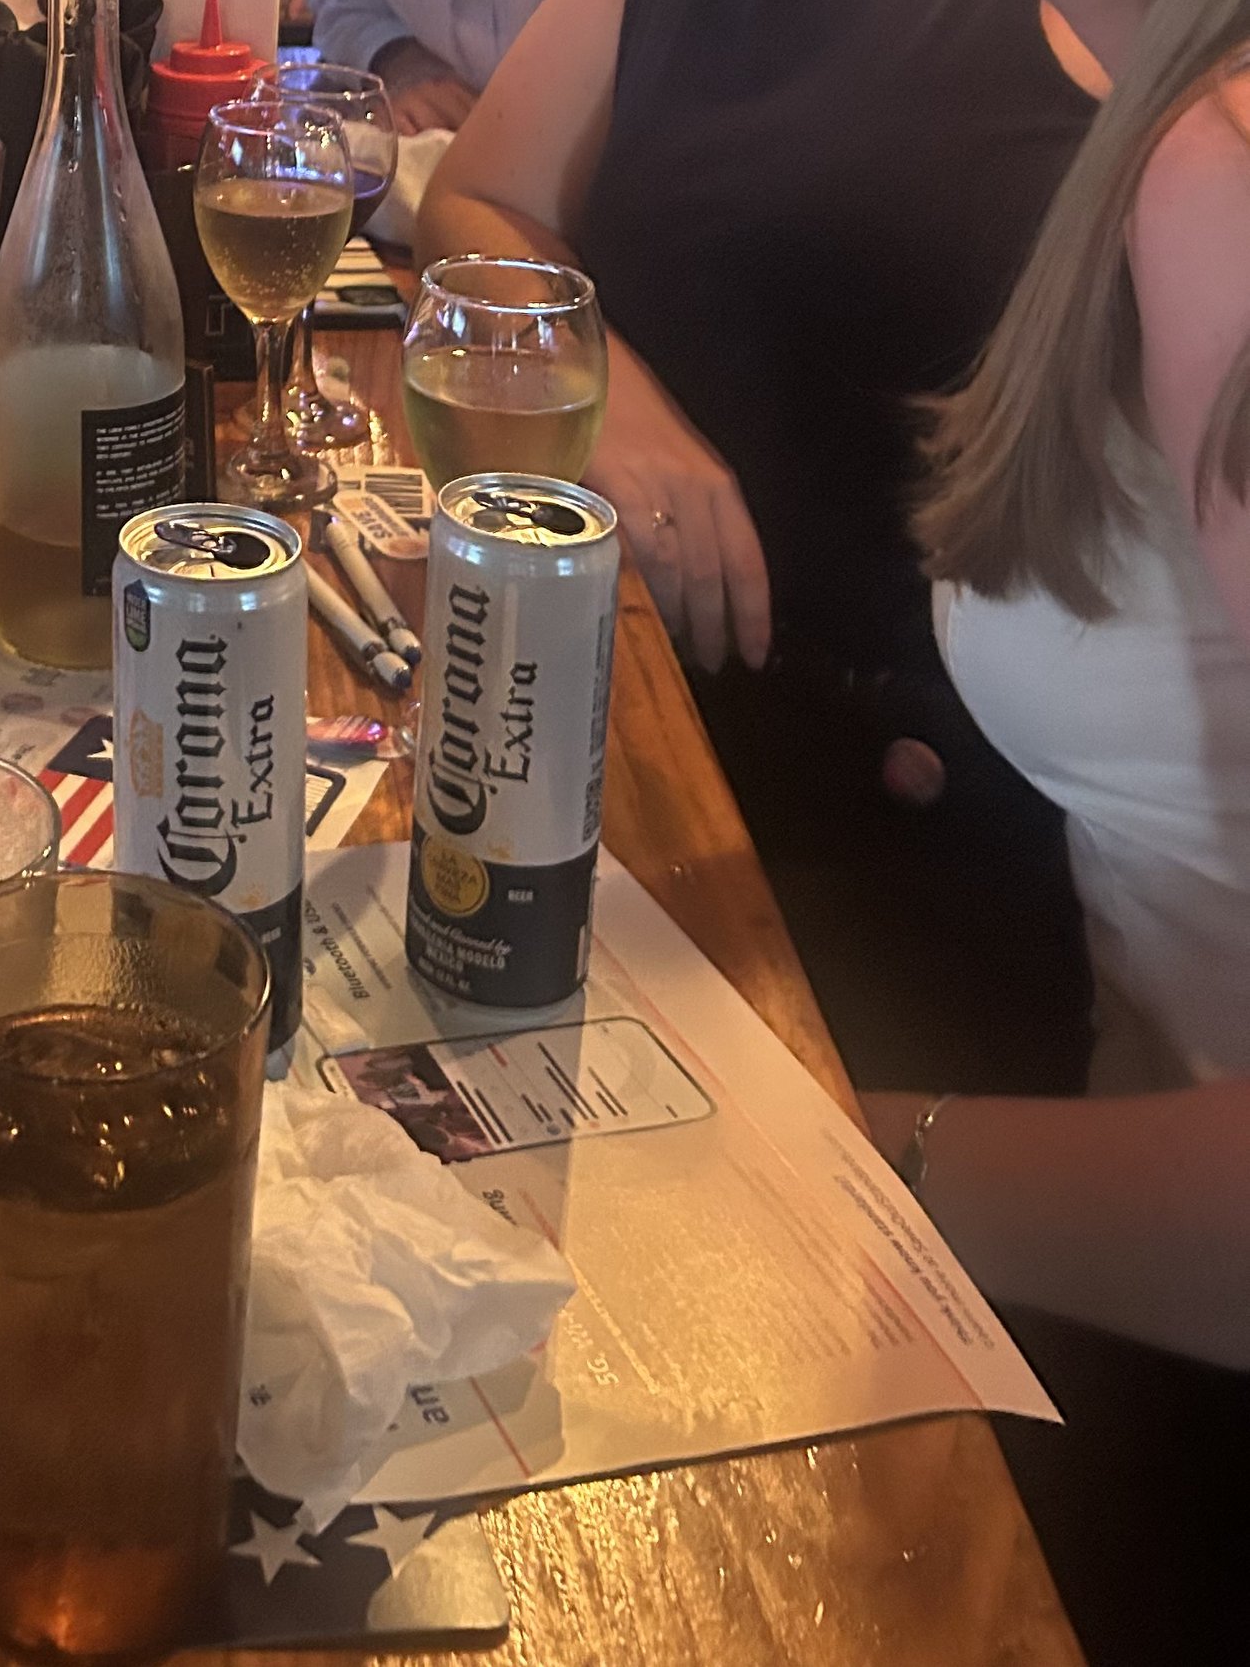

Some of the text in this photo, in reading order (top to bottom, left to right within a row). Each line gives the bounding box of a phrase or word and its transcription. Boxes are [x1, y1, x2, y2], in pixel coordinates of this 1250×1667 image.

[156, 634, 238, 897] Corona
[231, 692, 275, 831] Extra
[426, 581, 492, 836] Corona
[484, 659, 539, 785] Extra
[507, 888, 536, 903] BEER
[320, 936, 371, 1001] Bluetooth
